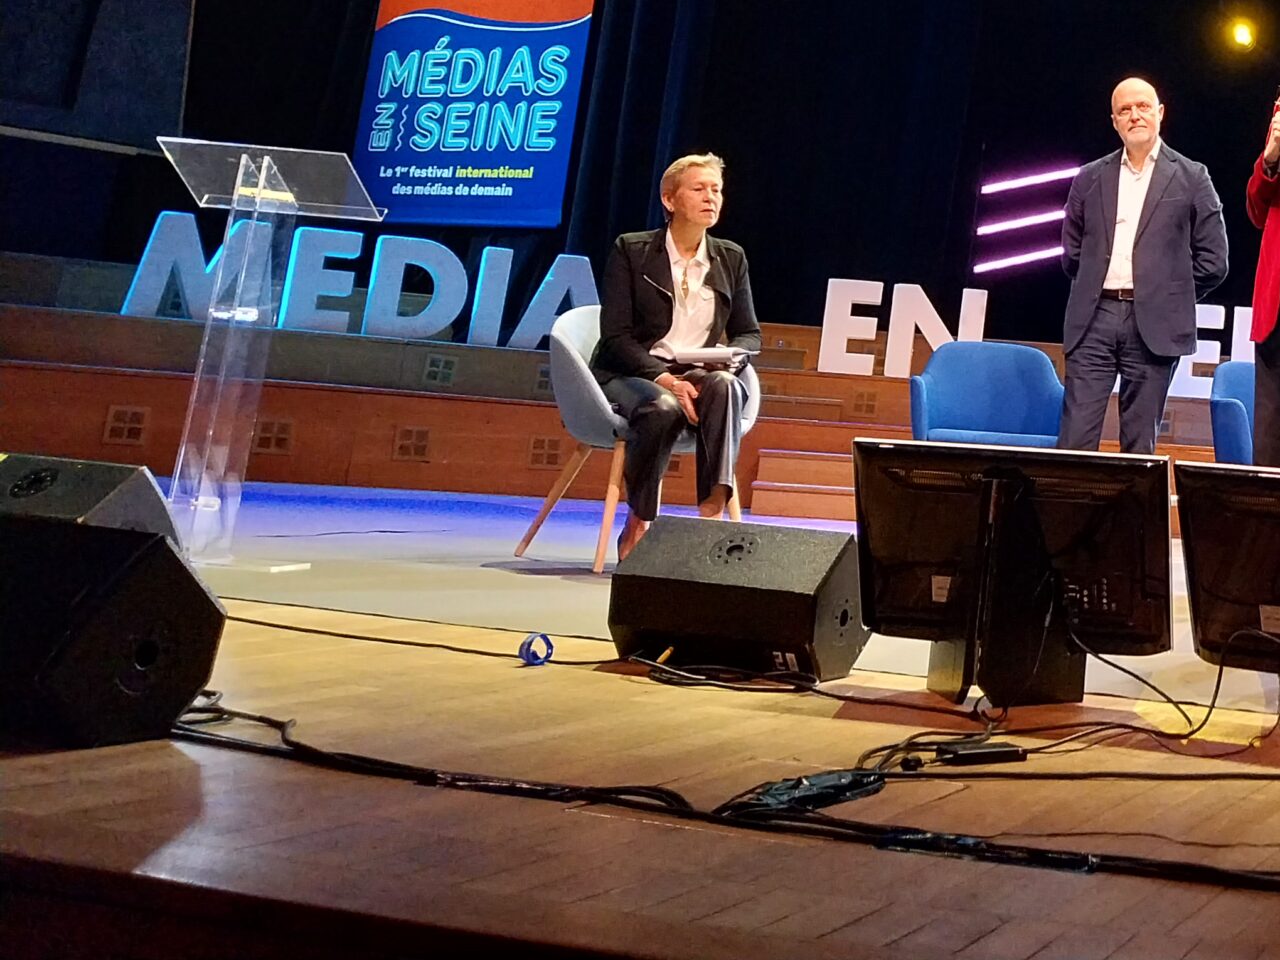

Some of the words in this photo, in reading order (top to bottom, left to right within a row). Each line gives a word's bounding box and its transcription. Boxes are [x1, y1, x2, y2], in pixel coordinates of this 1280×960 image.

[378, 36, 571, 98] MÉDIAS
[368, 101, 398, 152] EN
[410, 100, 563, 152] SEINE
[379, 166, 393, 178] Le
[409, 165, 453, 178] festival
[455, 166, 534, 179] international
[392, 183, 413, 195] des
[414, 183, 453, 196] médias
[455, 183, 469, 196] de
[470, 183, 513, 197] demain
[817, 278, 988, 377] EN
